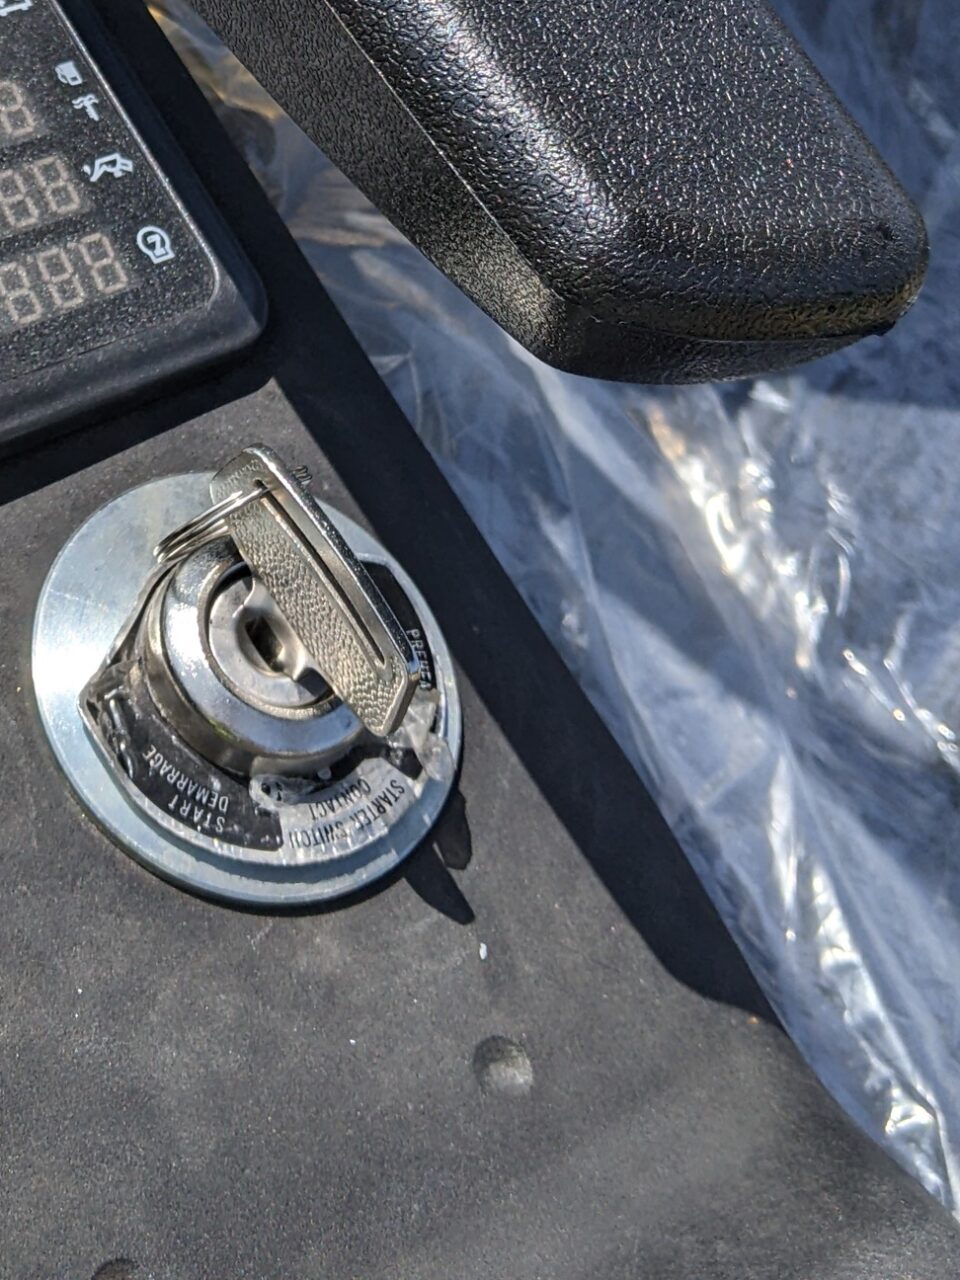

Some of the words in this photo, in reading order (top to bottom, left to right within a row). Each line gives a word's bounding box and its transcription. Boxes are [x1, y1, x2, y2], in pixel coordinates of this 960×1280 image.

[406, 628, 432, 689] PREHEA
[142, 744, 230, 812] DEMARRAGE
[308, 778, 372, 820] CONTACT
[167, 793, 226, 833] START
[355, 779, 406, 831] STARTER
